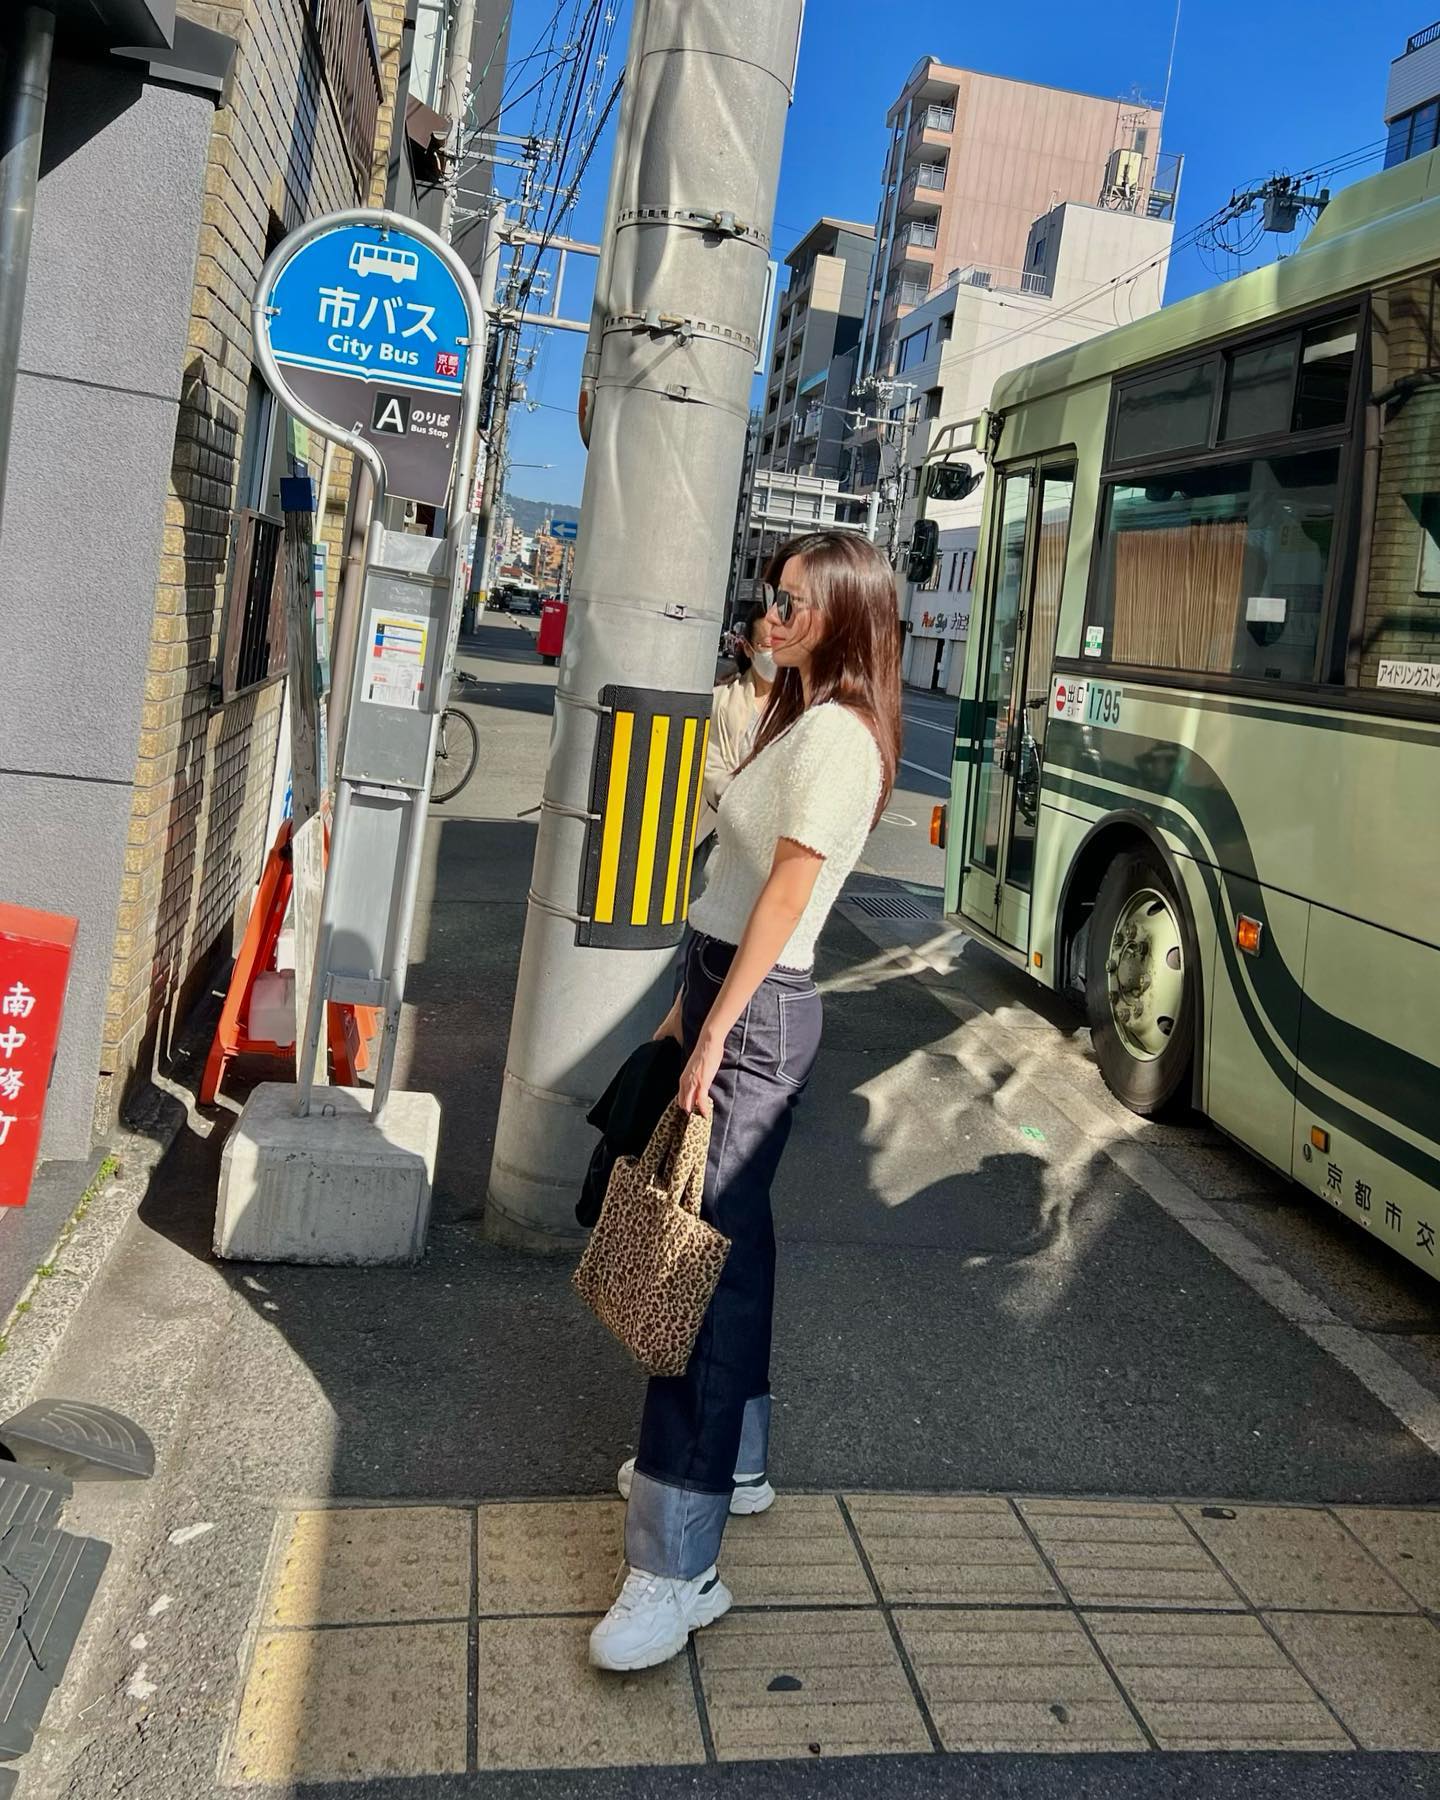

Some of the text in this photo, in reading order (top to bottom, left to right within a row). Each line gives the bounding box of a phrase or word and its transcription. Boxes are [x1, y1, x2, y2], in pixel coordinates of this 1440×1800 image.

[318, 286, 438, 343] 市バス
[328, 334, 419, 365] City Bus
[437, 353, 460, 367] 京都
[436, 365, 457, 377] バス
[376, 398, 404, 433] A
[412, 409, 451, 427] のりば
[411, 424, 448, 439] Bus Stop
[1067, 684, 1085, 704] 出口
[1089, 687, 1122, 724] 1795
[1327, 1161, 1435, 1257] 京都市交
